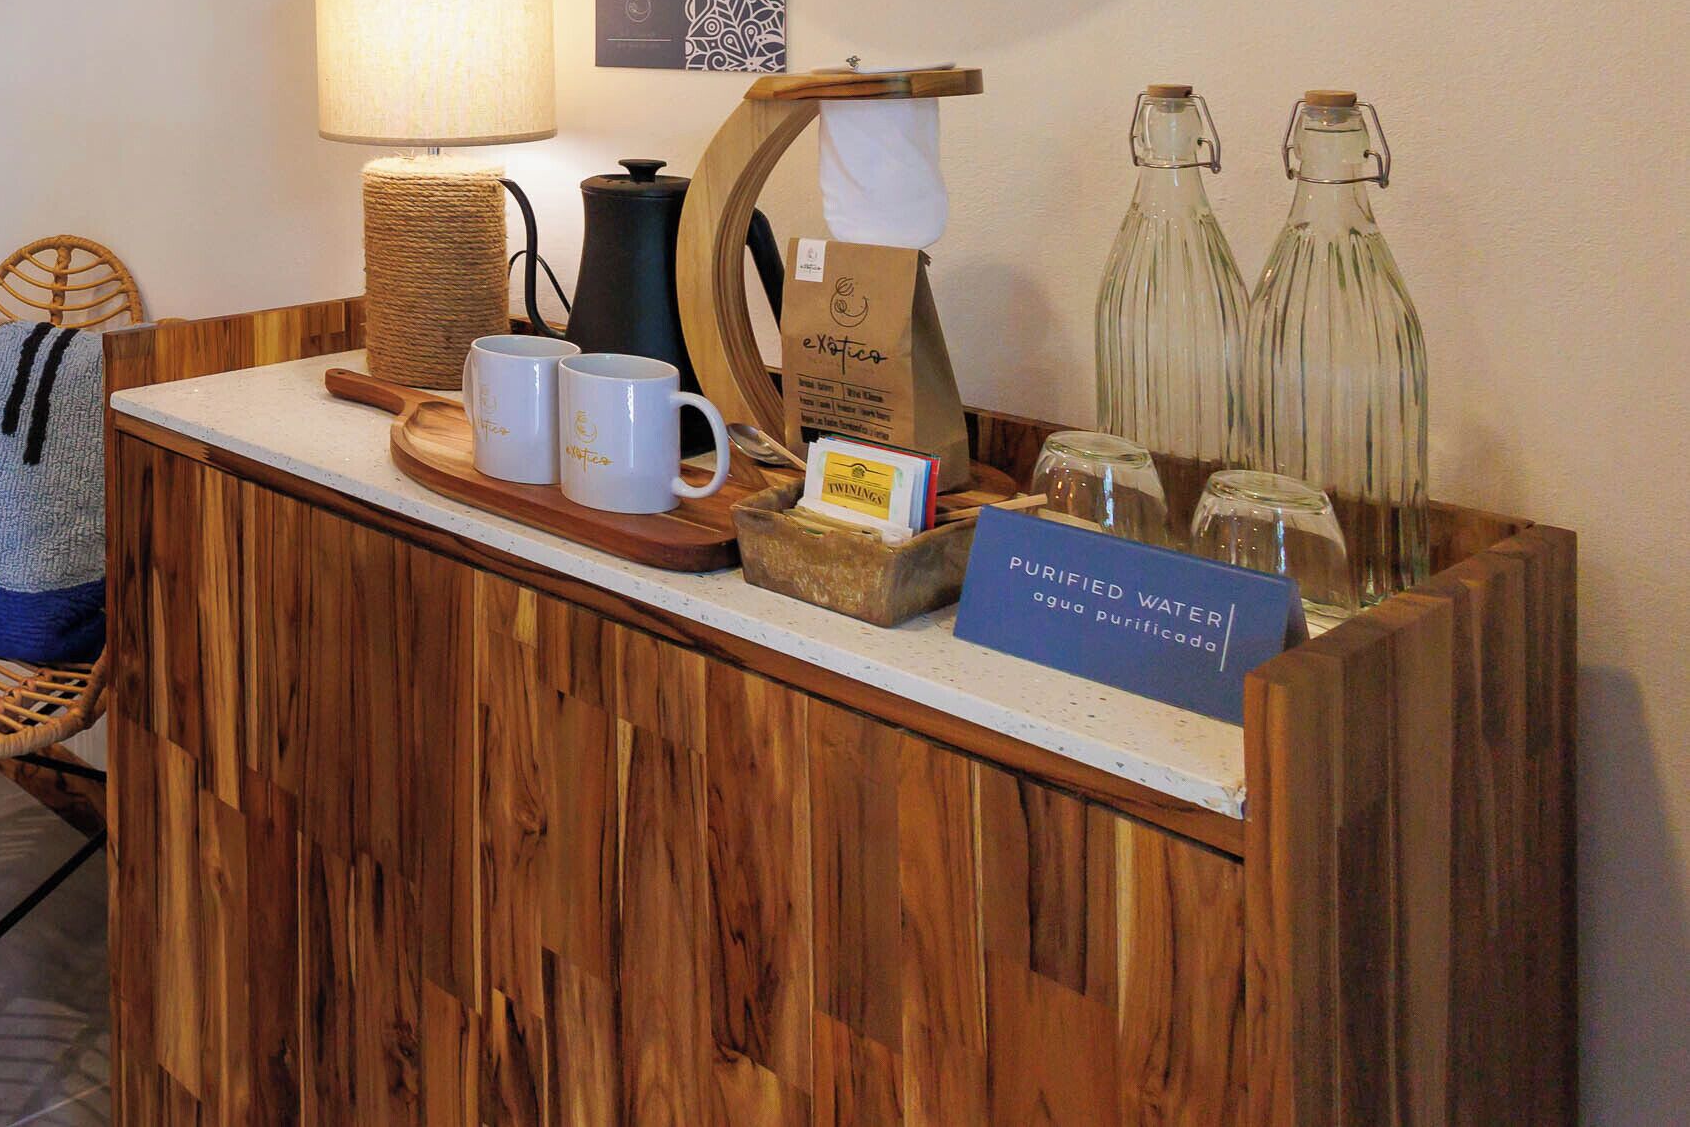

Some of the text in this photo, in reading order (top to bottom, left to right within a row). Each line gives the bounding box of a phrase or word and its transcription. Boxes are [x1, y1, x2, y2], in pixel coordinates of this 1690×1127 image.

[827, 482, 885, 506] TWININGS
[1009, 555, 1223, 629] PURIFIED WATER
[1032, 589, 1218, 654] agua purificada
